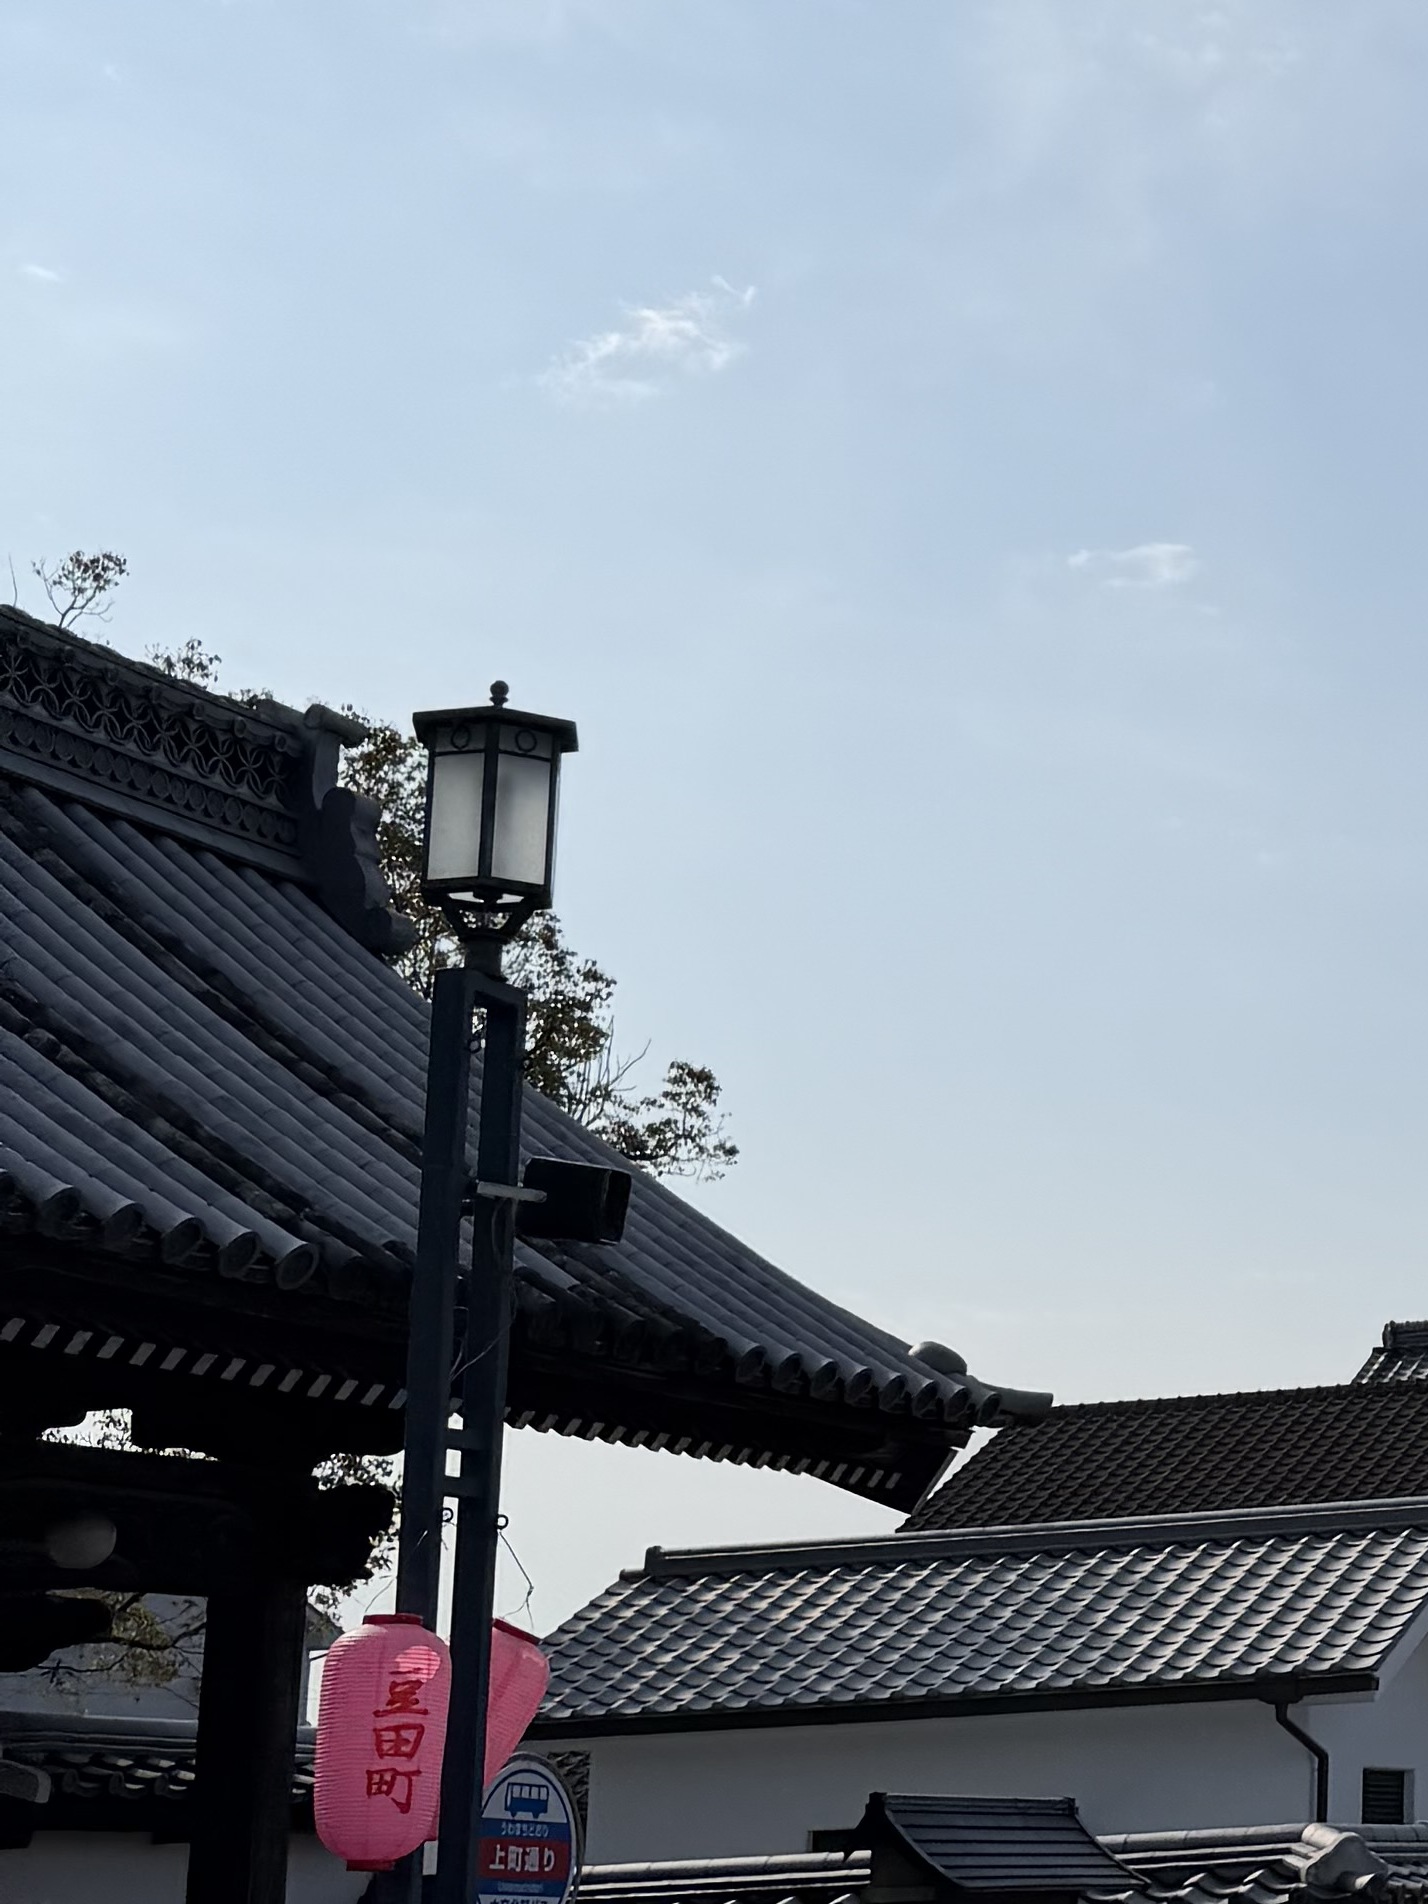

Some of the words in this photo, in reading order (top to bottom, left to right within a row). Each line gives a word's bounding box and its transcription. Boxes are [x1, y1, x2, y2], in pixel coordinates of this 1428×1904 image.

[365, 1668, 429, 1814] 豆田町
[488, 1844, 556, 1873] 上町通り
